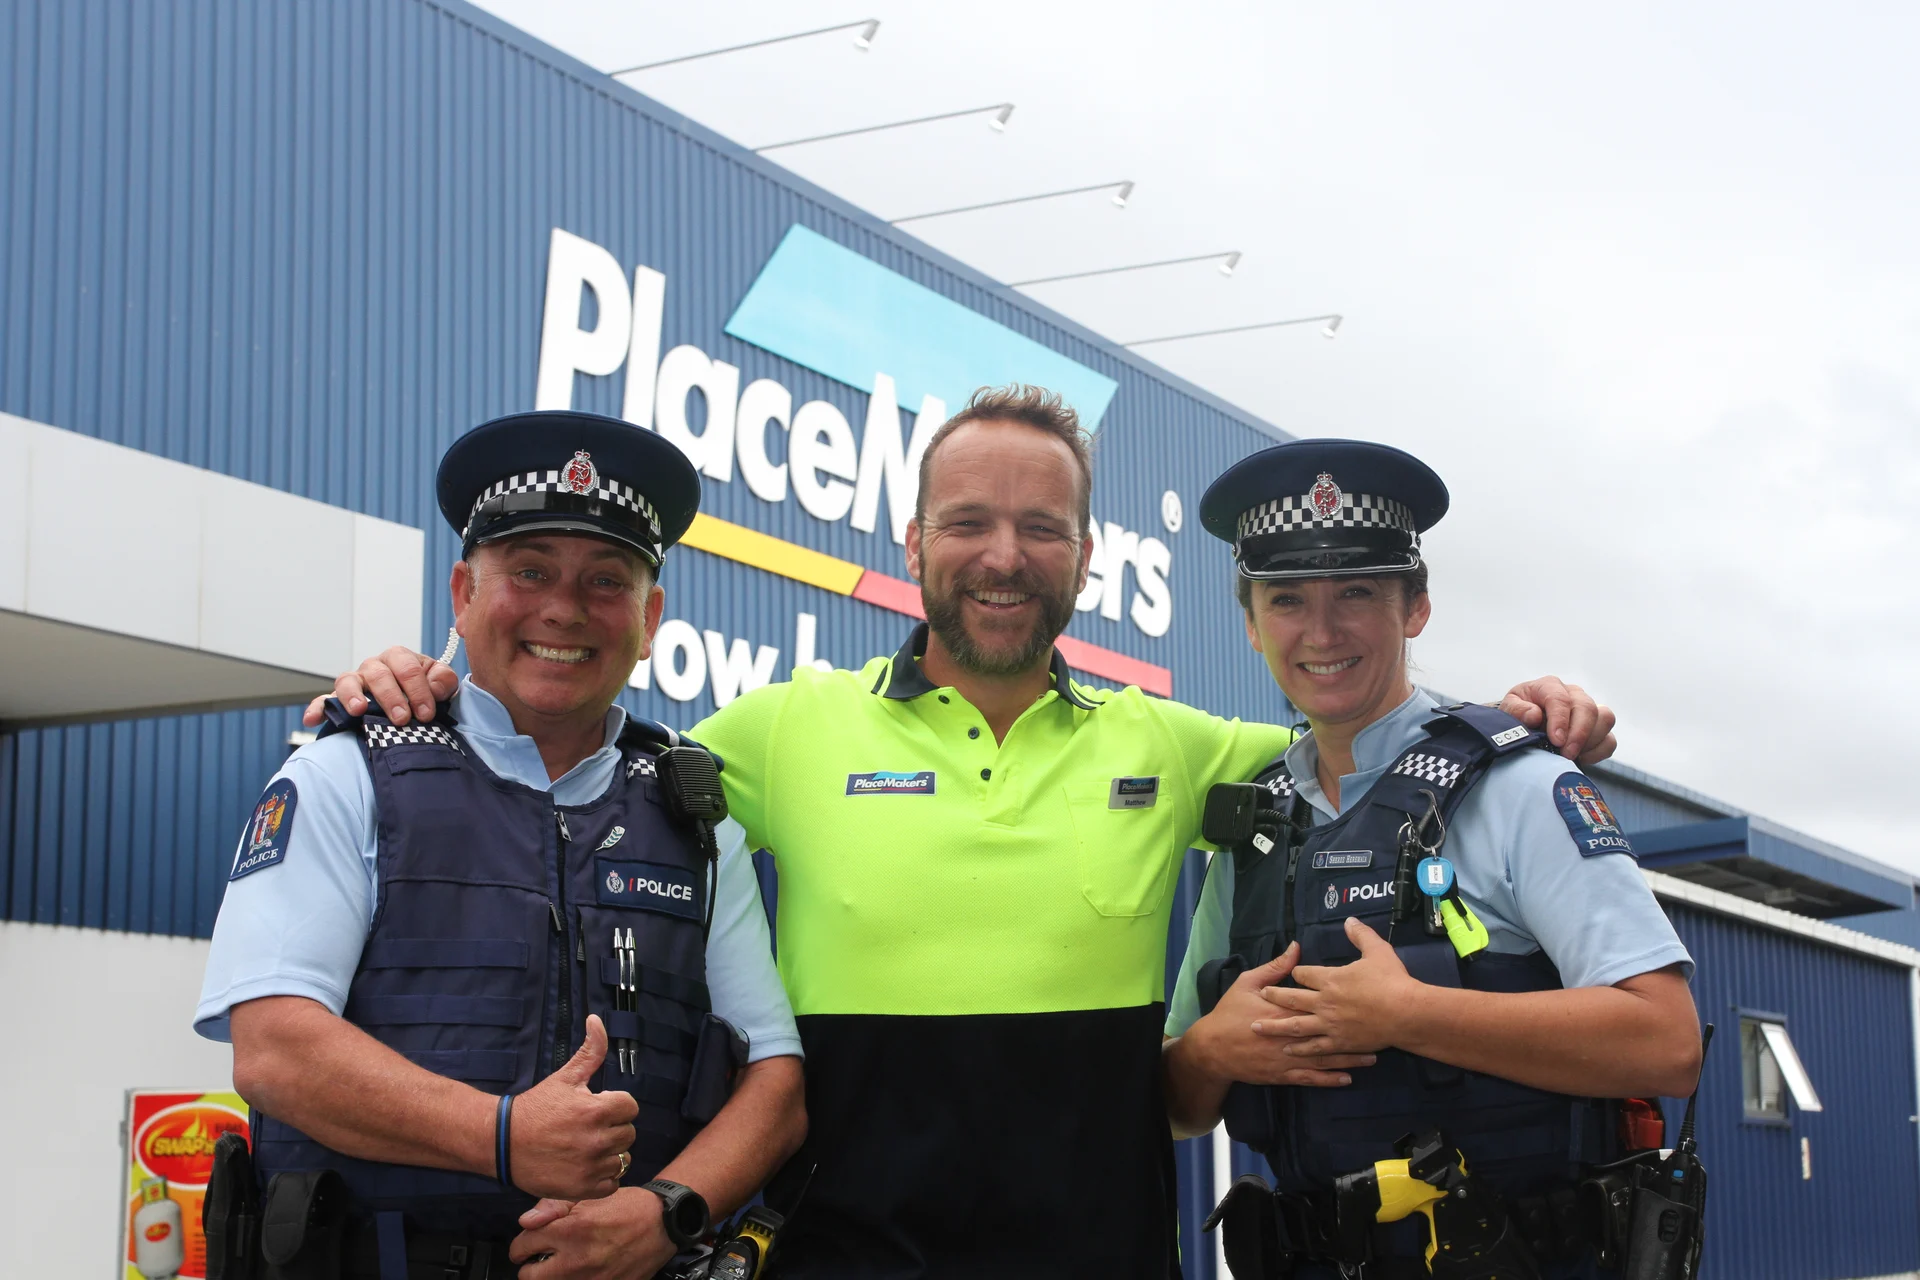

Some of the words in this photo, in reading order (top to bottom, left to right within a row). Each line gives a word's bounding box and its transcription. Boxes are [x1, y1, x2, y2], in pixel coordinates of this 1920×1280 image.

[854, 777, 927, 788] PlaceMakers
[238, 848, 278, 872] POLICE
[637, 878, 692, 901] POLICE
[1349, 881, 1395, 902] POLIC
